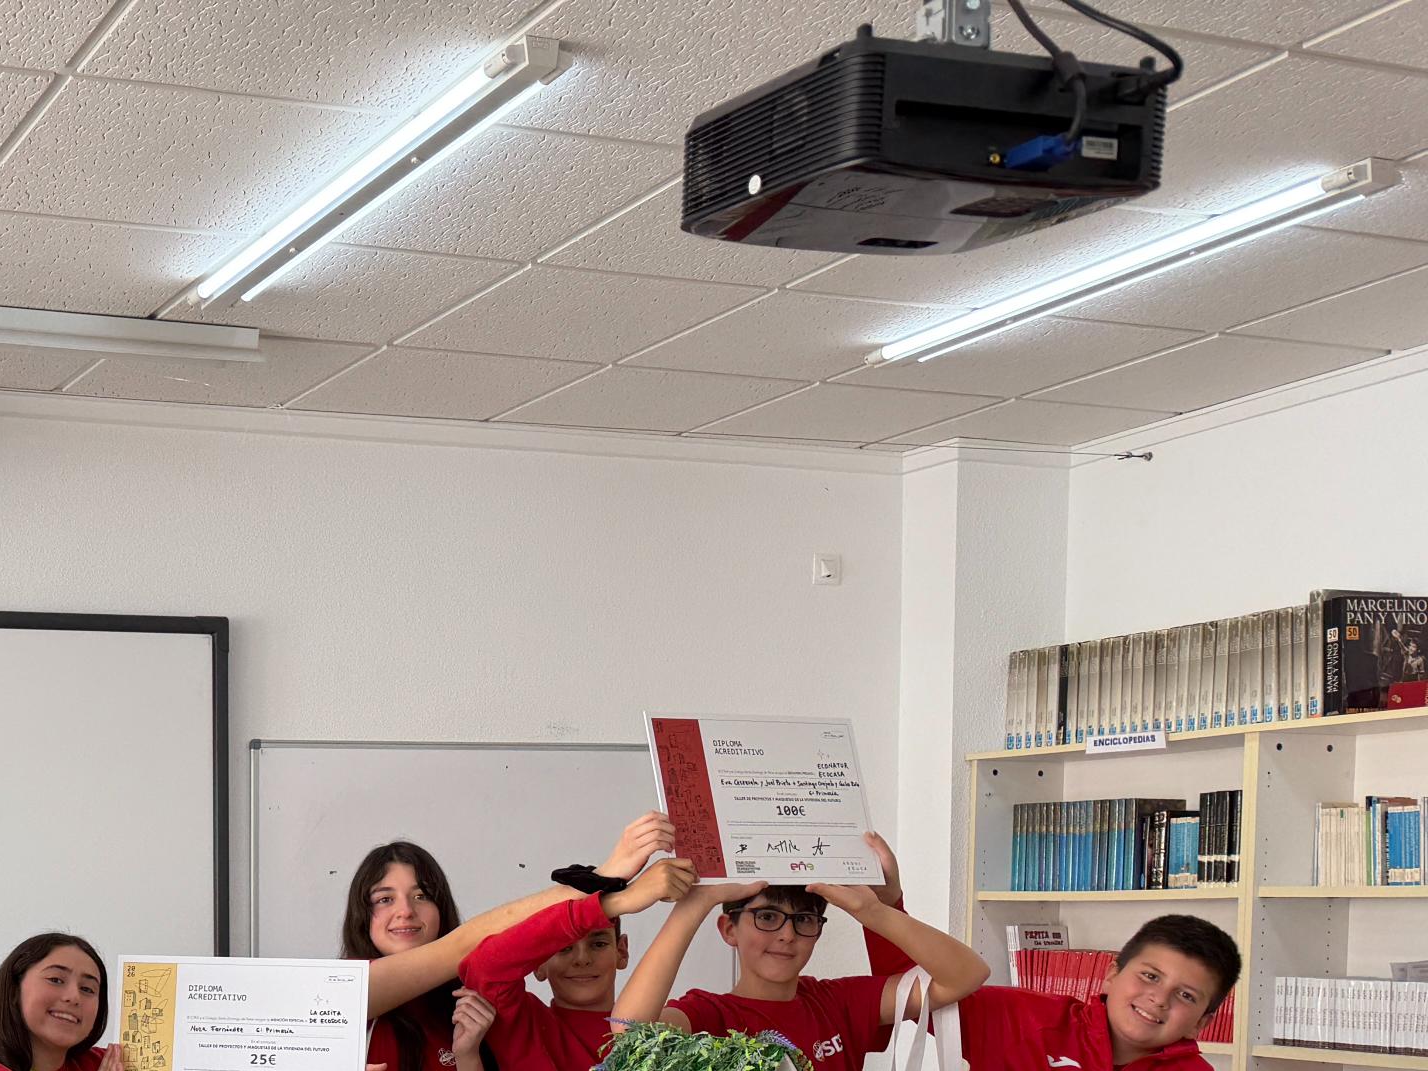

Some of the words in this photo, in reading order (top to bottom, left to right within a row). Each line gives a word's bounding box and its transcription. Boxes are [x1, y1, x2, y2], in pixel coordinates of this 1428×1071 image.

[1346, 599, 1428, 612] MARCELINO
[1346, 612, 1374, 625] PAN
[1378, 612, 1388, 624] Y
[1392, 612, 1428, 625] VINO
[1328, 629, 1337, 639] 50
[1347, 628, 1358, 637] 50
[1093, 734, 1156, 746] ENCICLOPEDIAS
[714, 748, 765, 756] ACREDITATIVO
[776, 805, 806, 816] 100€
[188, 984, 223, 993] DIPLOMA
[188, 993, 247, 1001] ACREDITATIVO
[821, 1033, 843, 1056] SD
[250, 1053, 276, 1065] 25€
